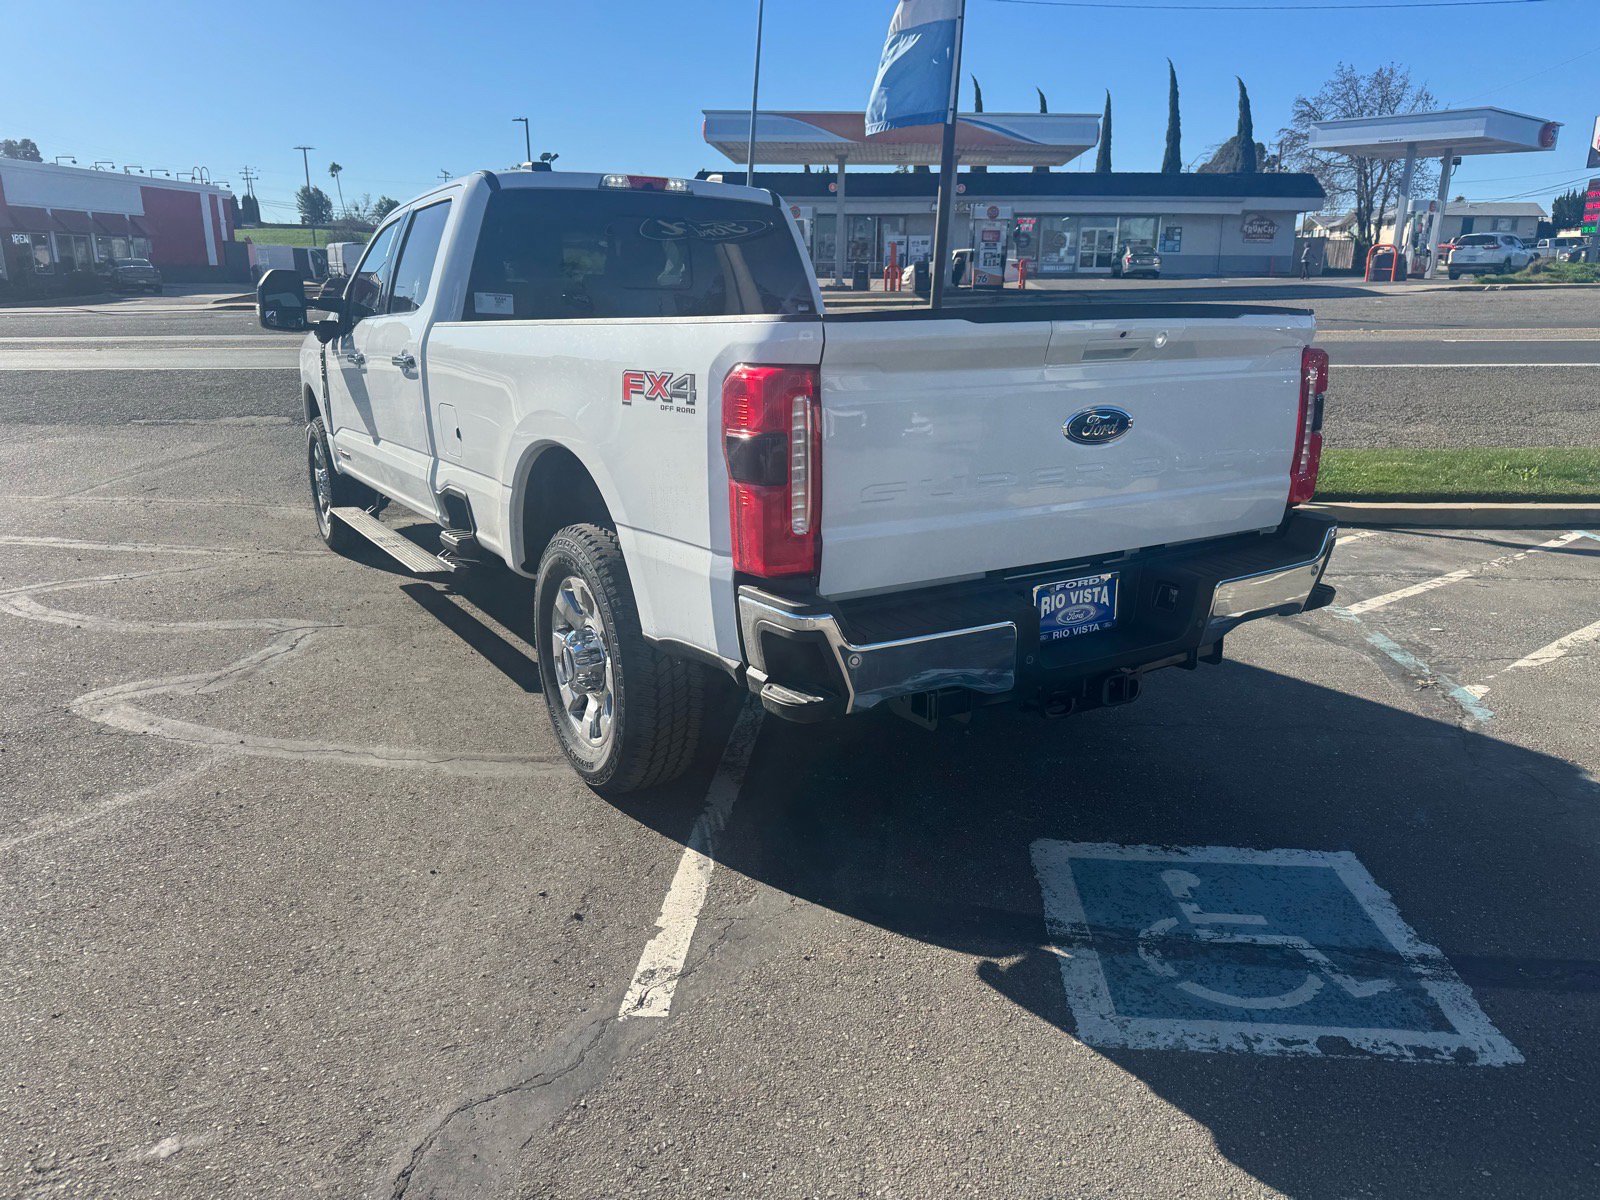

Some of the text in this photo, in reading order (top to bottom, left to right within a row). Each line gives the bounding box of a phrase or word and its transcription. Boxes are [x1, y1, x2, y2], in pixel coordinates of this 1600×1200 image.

[622, 369, 697, 407] FX4
[660, 404, 675, 412] OFF
[1080, 413, 1120, 438] Ford
[1055, 578, 1100, 591] FORD
[1040, 585, 1110, 619] RIO VISTA
[1067, 610, 1085, 620] Ford
[1052, 629, 1070, 640] RIO
[1072, 623, 1100, 636] VISTA
